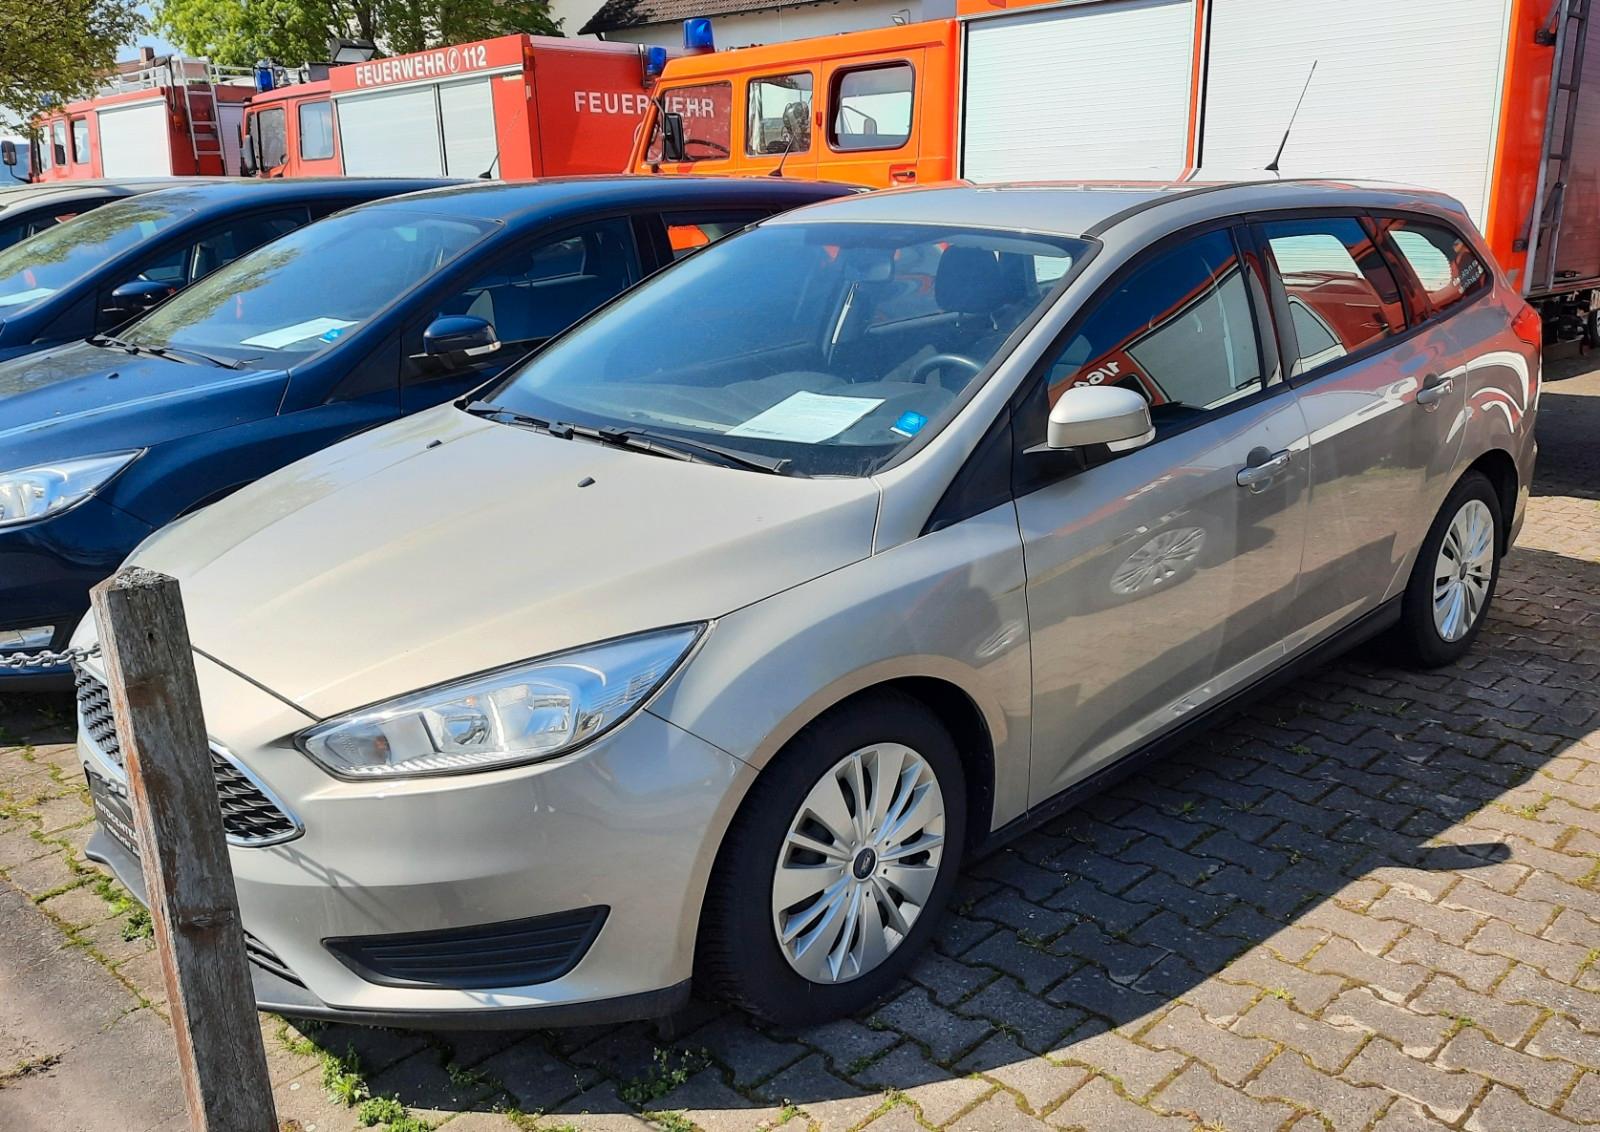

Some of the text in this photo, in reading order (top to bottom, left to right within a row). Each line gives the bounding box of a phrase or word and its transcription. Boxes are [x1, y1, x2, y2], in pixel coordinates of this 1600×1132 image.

[355, 45, 487, 86] FEUERWEHR 112
[574, 91, 715, 118] FEUEREHR
